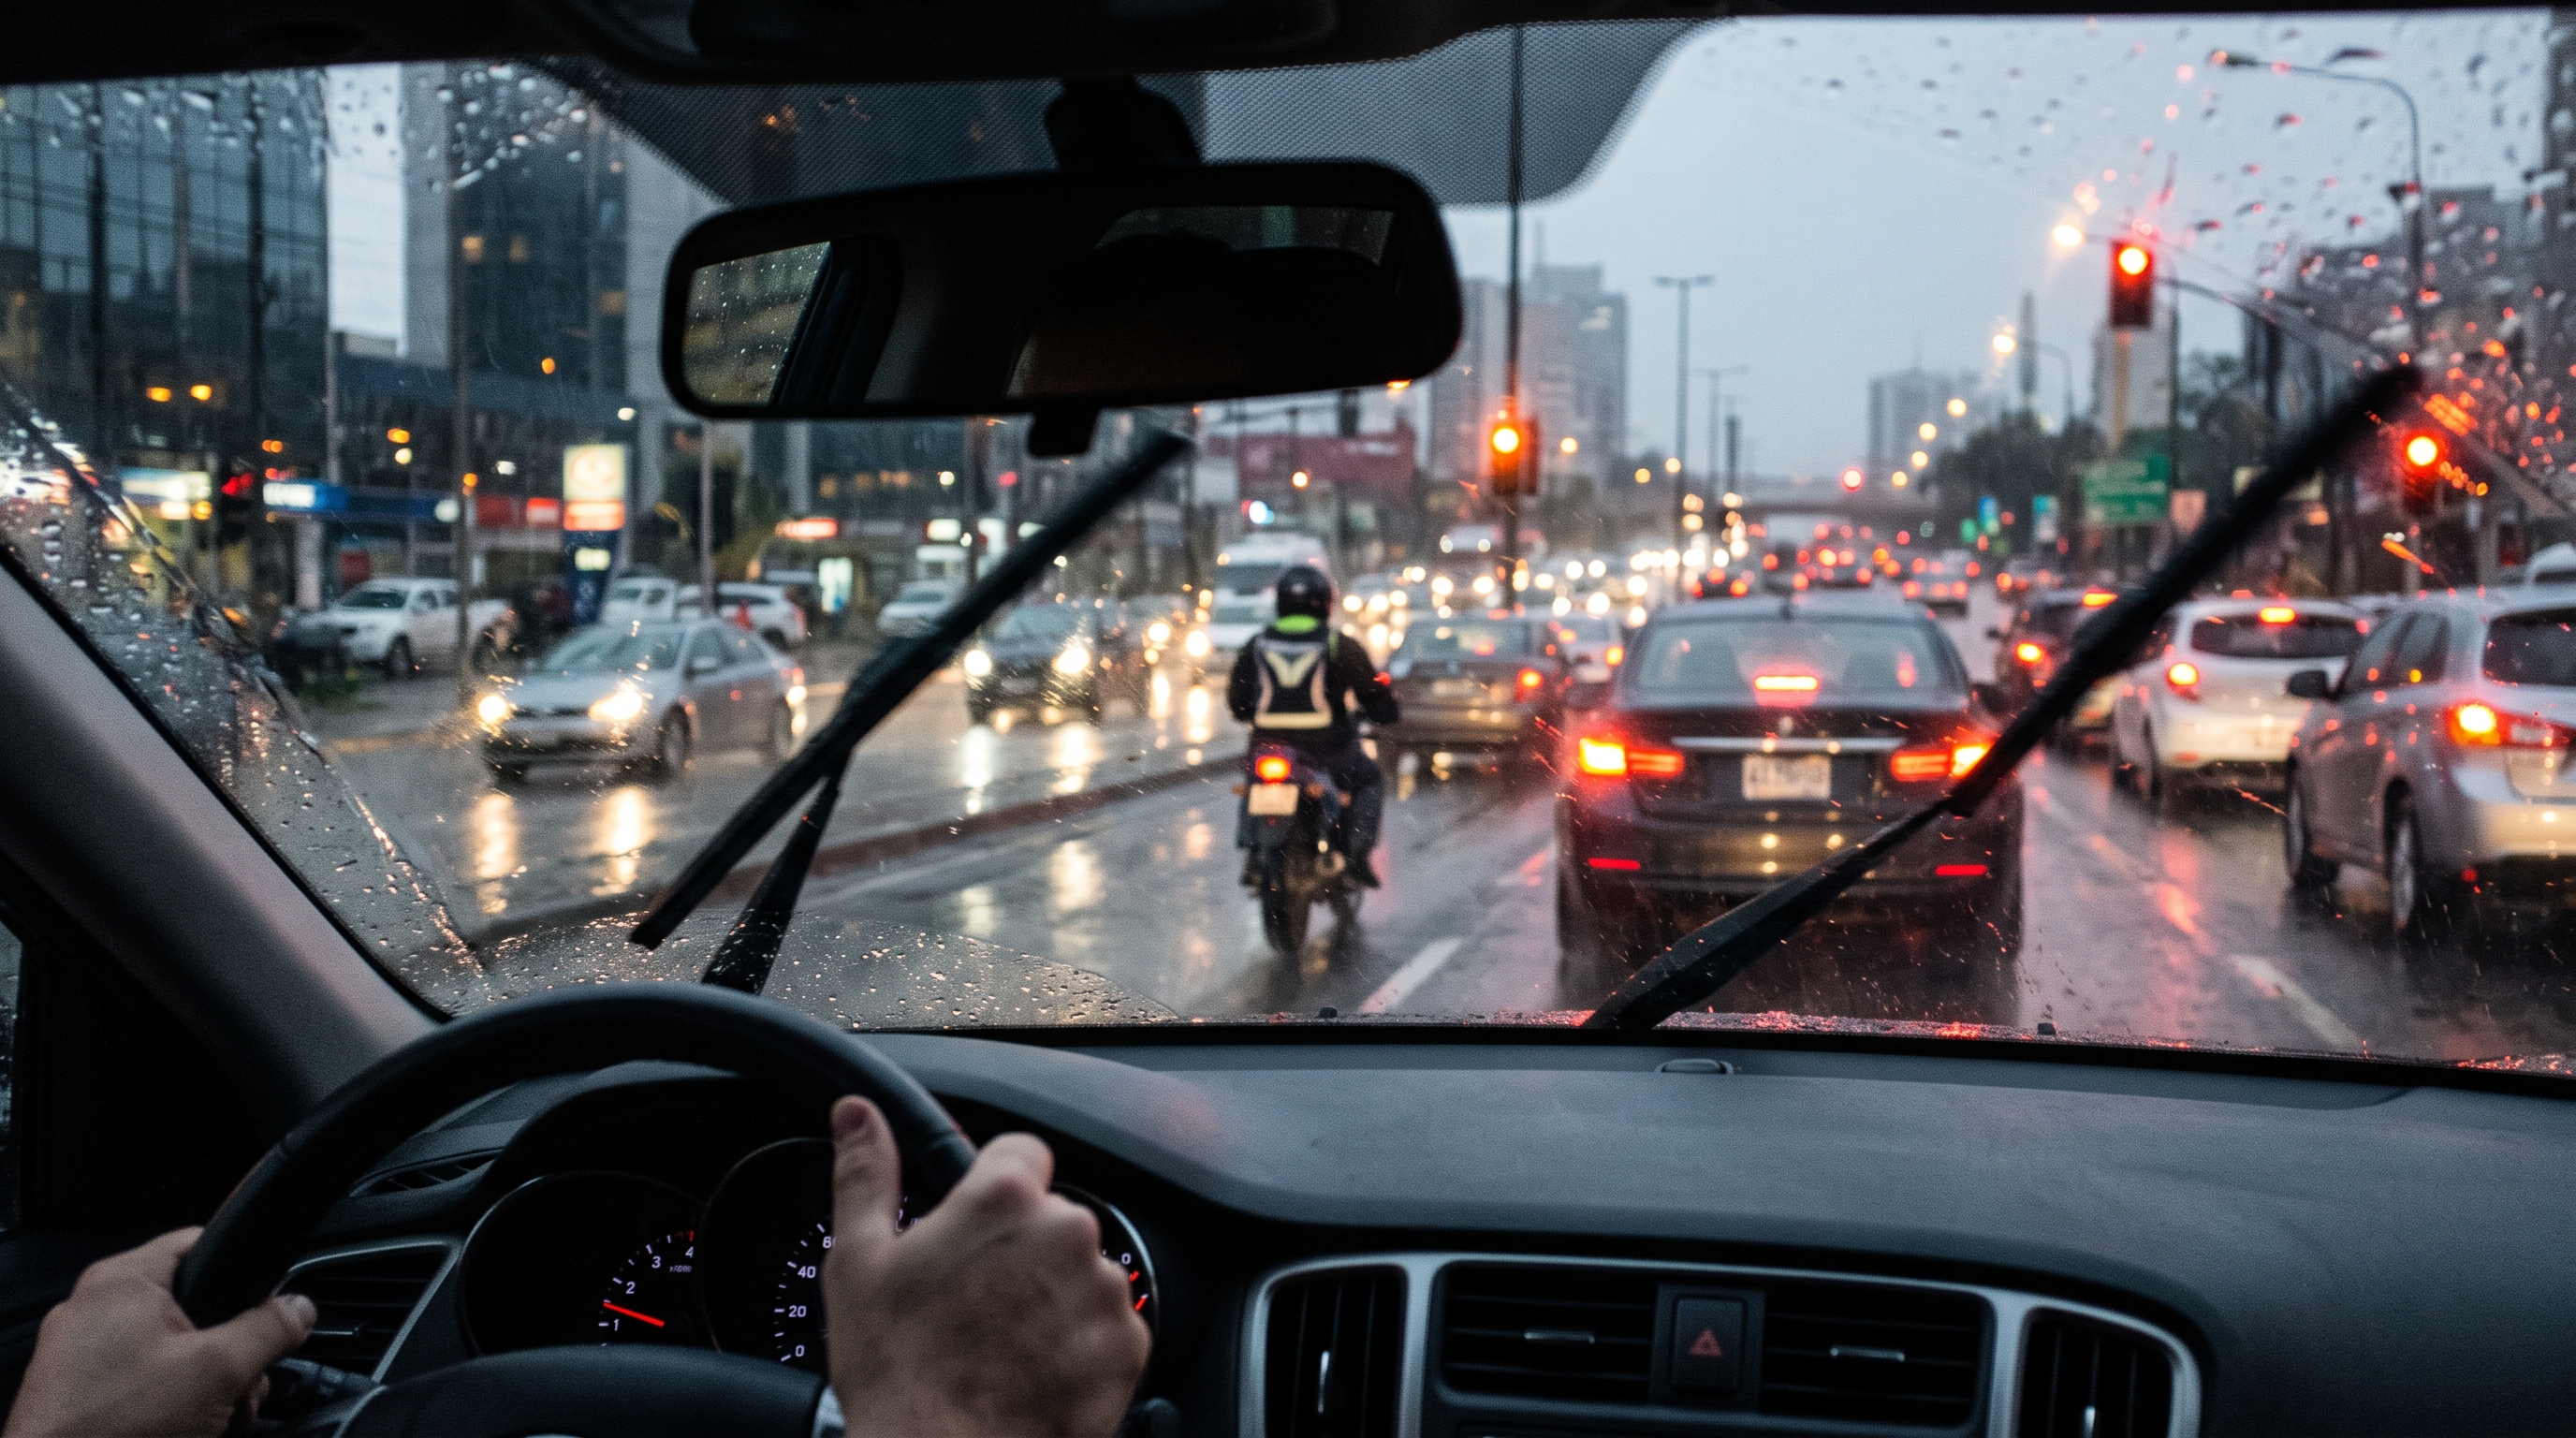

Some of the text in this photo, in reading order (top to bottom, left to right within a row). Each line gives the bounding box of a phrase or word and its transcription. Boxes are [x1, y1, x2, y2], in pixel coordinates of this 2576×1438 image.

[684, 1246, 695, 1258] 4
[651, 1255, 661, 1269] 3
[1120, 1253, 1132, 1265] 0
[797, 1266, 816, 1278] 40
[625, 1281, 636, 1294] 2
[788, 1305, 807, 1317] 20
[613, 1318, 620, 1331] 1
[795, 1344, 805, 1357] 0
